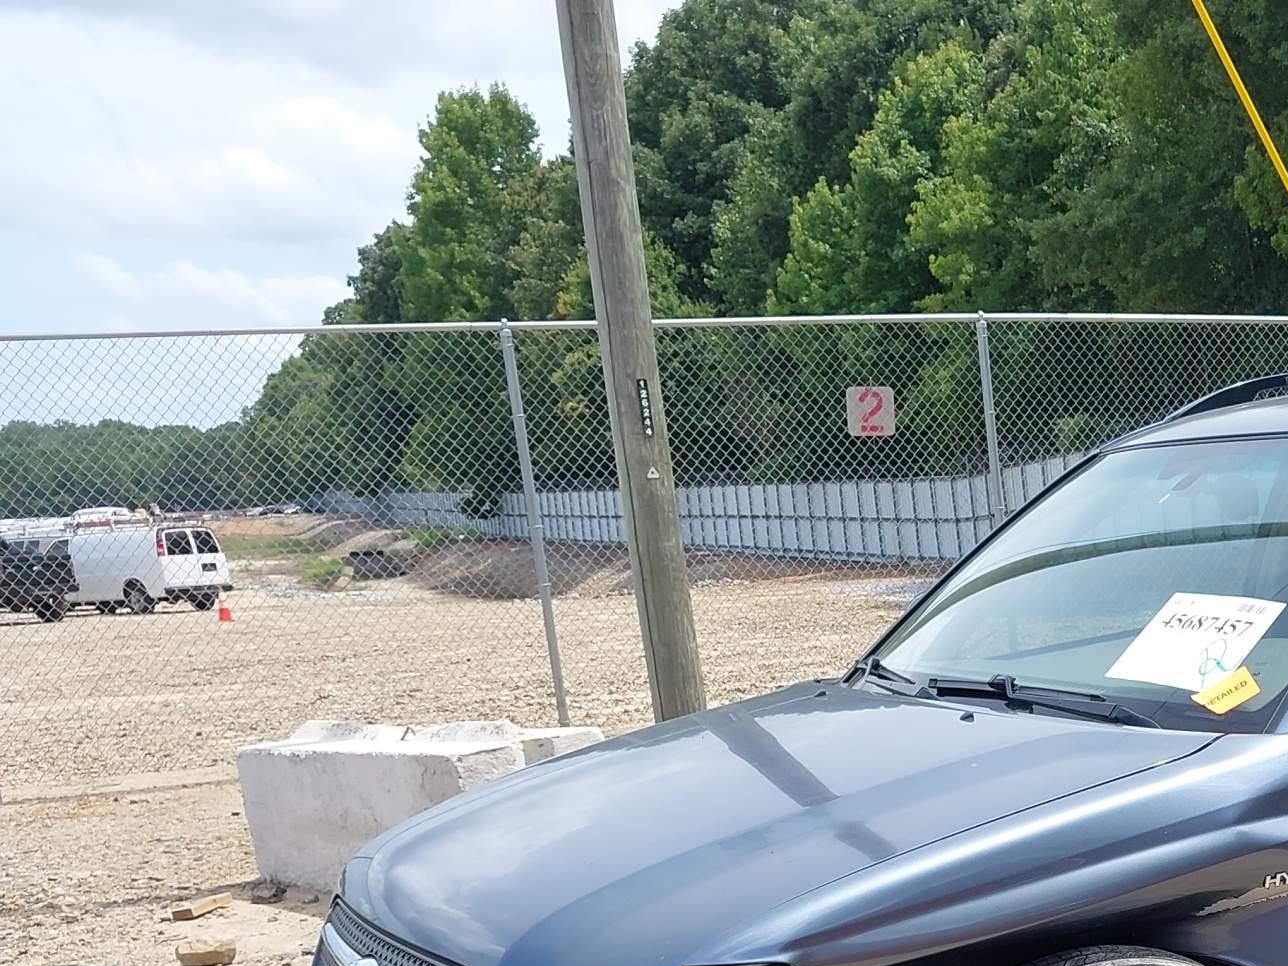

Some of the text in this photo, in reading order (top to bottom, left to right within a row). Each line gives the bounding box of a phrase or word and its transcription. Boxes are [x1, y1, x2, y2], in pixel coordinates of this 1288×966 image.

[639, 379, 653, 437] 126244
[858, 389, 884, 433] 2
[1162, 613, 1254, 637] 45687457
[1207, 680, 1248, 706] ETAILED
